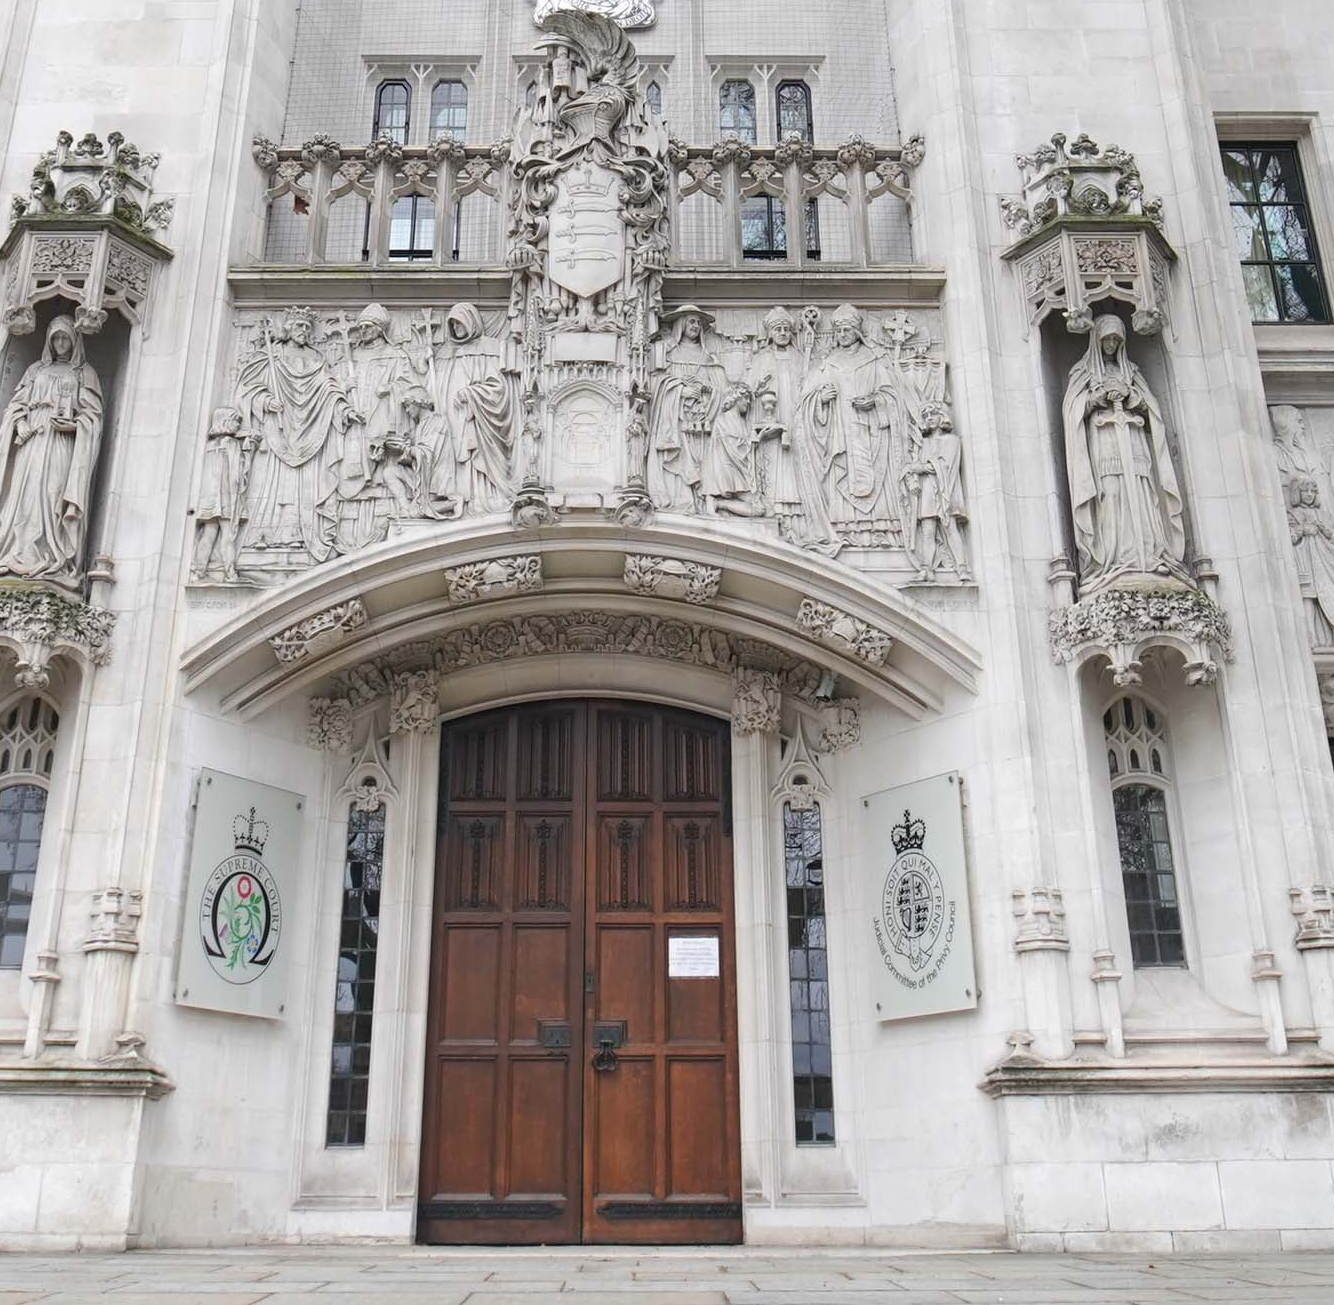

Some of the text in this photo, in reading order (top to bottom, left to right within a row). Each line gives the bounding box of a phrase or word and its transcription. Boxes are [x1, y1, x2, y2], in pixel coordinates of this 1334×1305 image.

[203, 857, 280, 935] THE SUPREME COURT
[885, 857, 942, 939] HONI SOIT QUI MAL Y PENSE
[873, 900, 955, 989] Judicial Committee of the Privy Council
